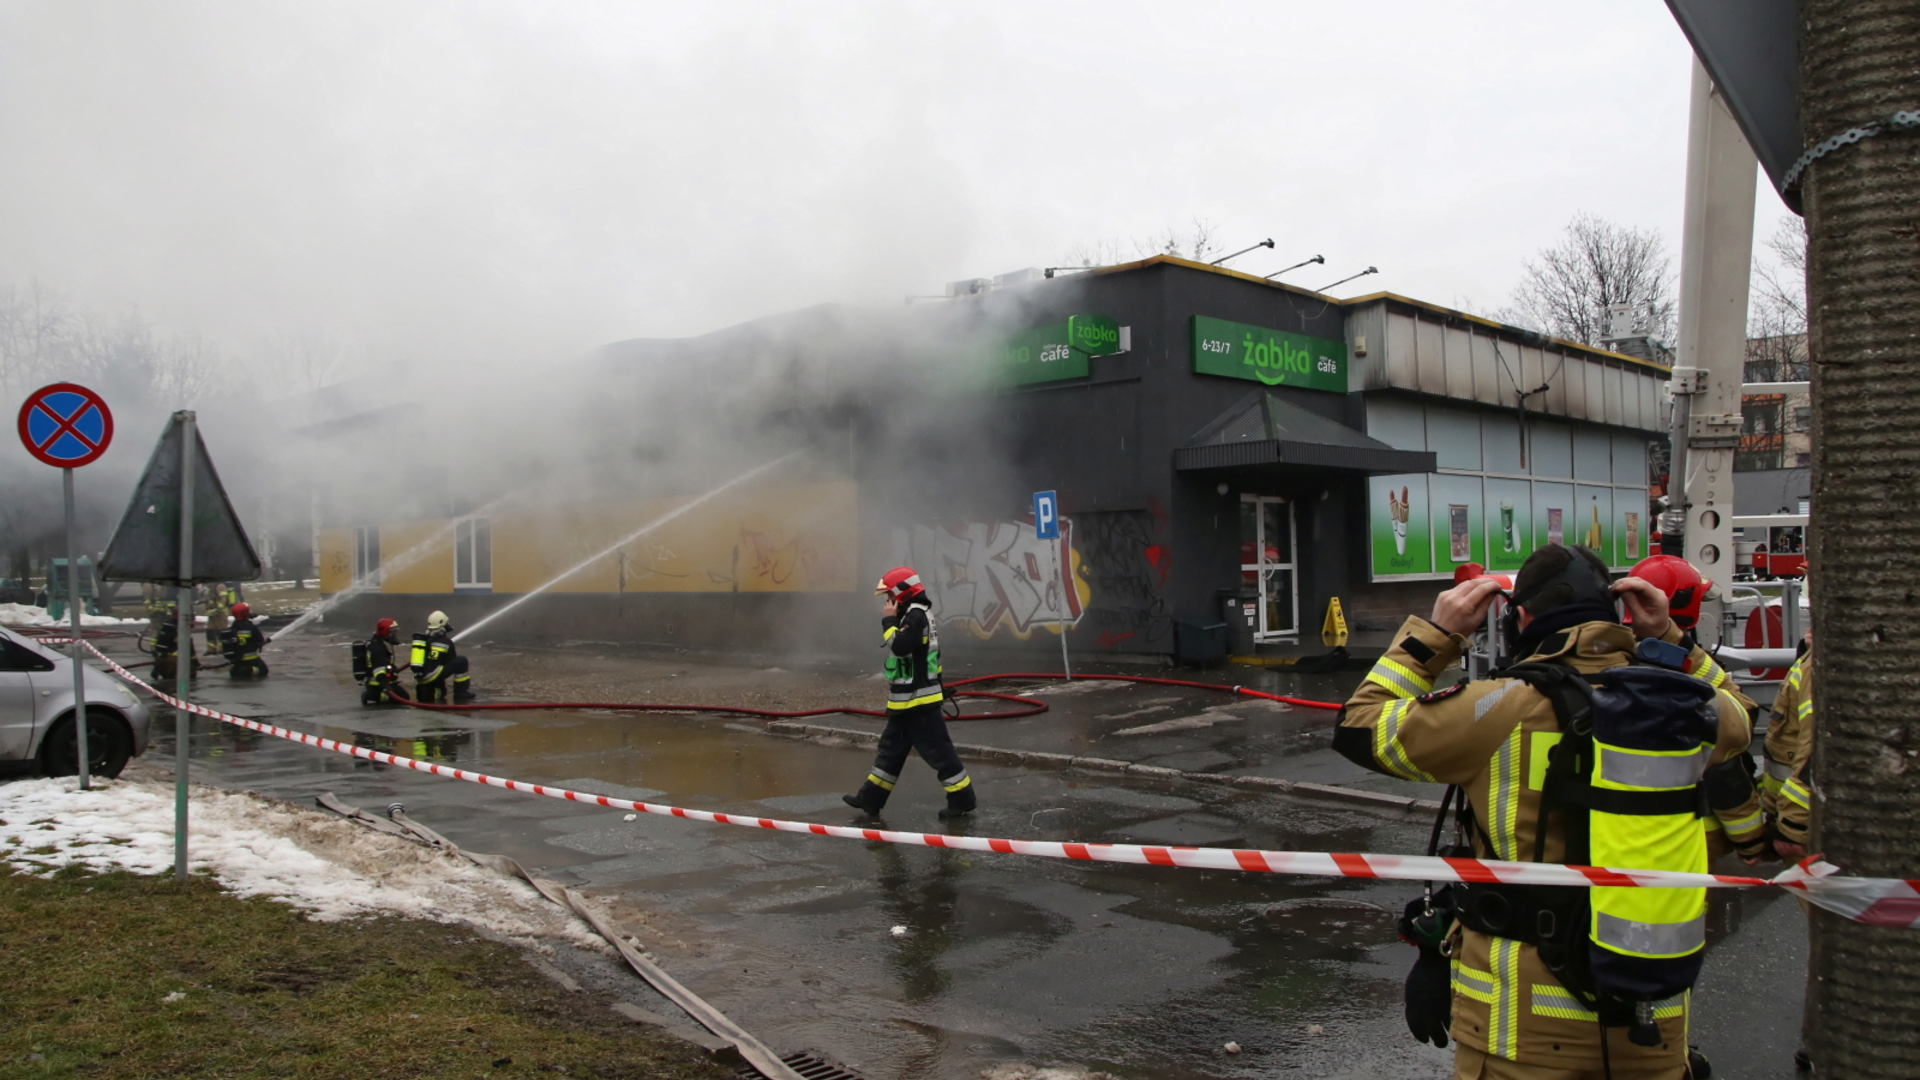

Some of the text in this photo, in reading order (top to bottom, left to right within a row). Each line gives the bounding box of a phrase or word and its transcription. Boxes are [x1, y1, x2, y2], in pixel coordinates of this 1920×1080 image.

[1077, 322, 1117, 342] żabka
[1040, 344, 1070, 362] café
[1202, 339, 1231, 354] 6-23/7
[1242, 332, 1311, 374] żabka
[1039, 497, 1053, 533] P
